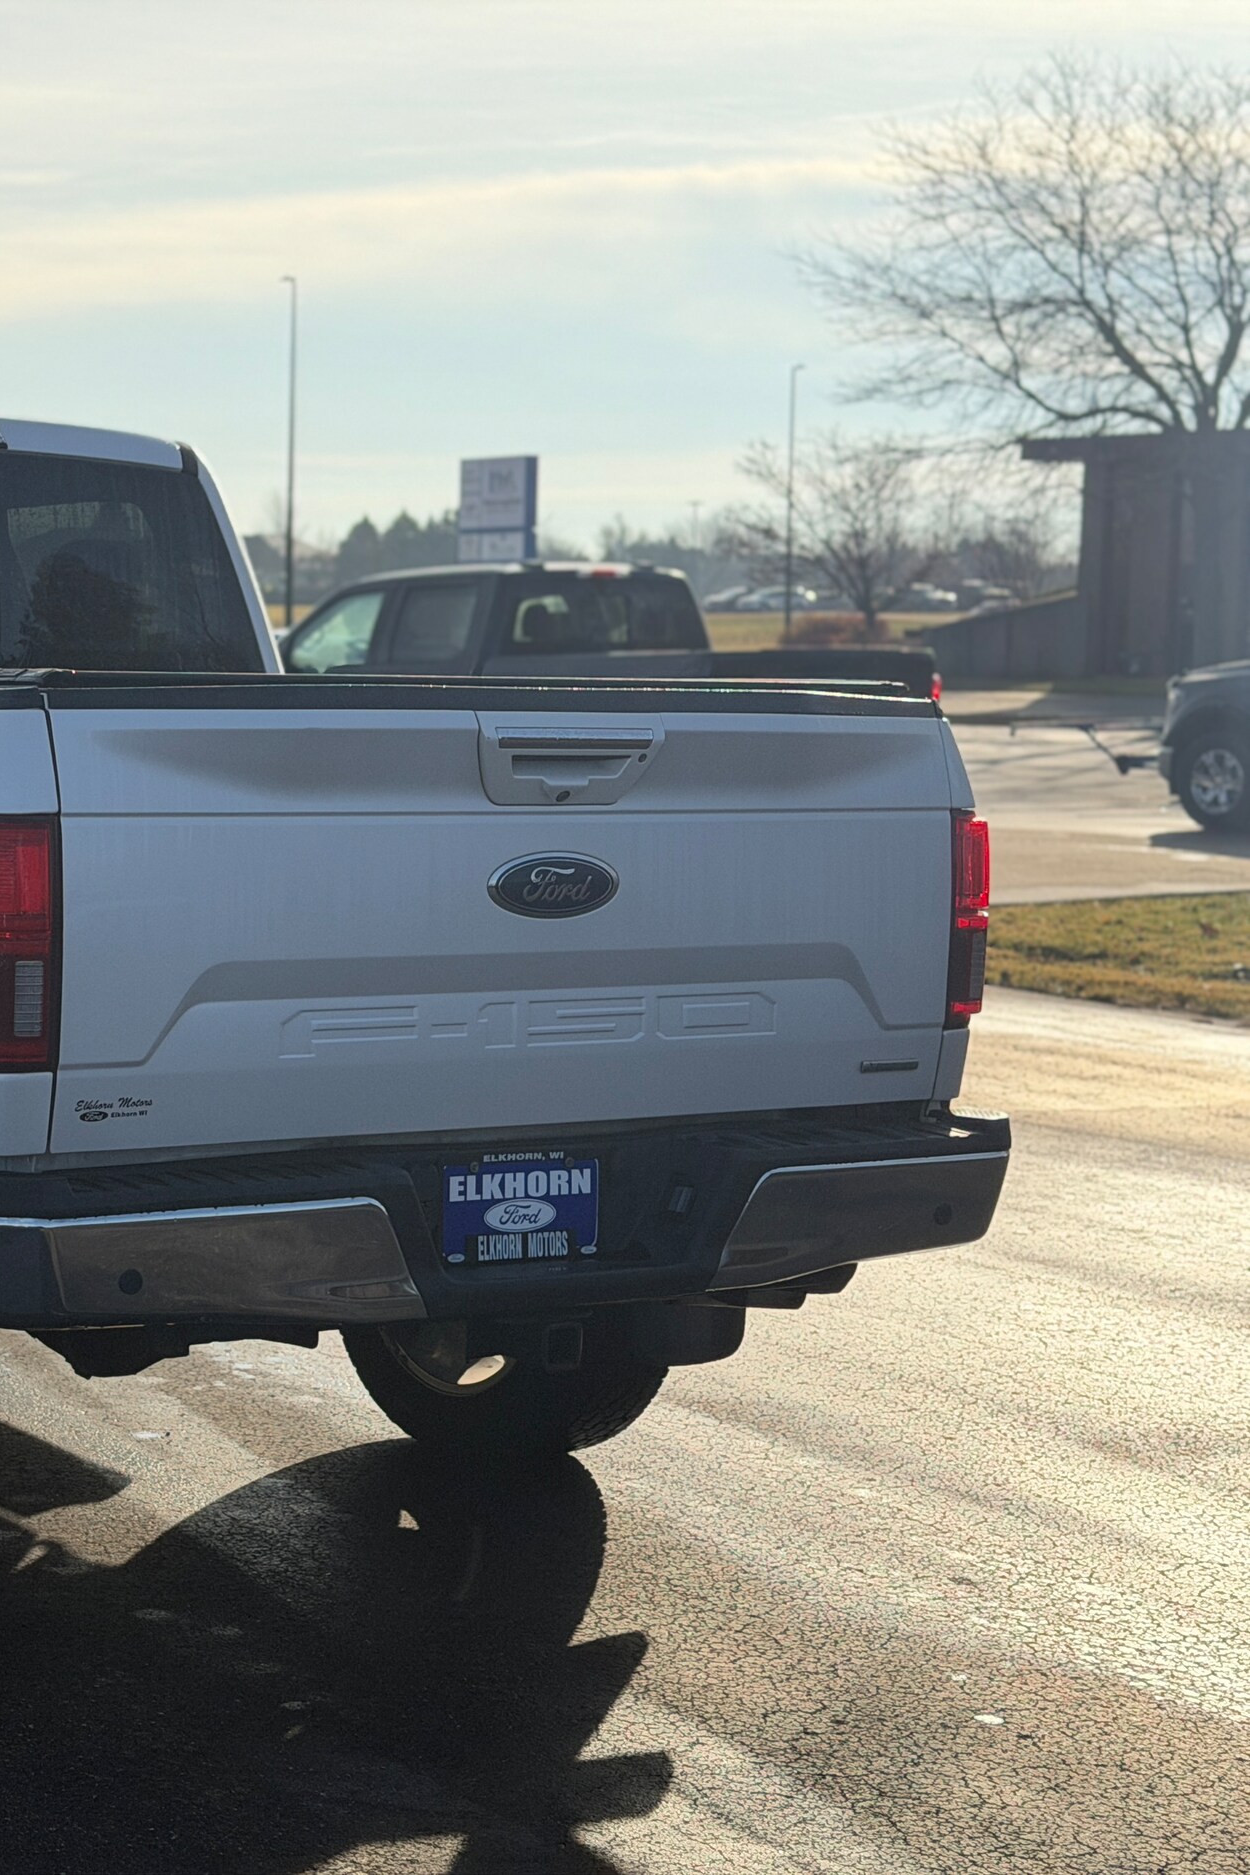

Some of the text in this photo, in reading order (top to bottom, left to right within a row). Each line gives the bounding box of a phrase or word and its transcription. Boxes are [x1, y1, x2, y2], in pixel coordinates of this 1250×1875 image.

[523, 866, 593, 901] Ford
[74, 1097, 153, 1112] Elkhorn Motors
[483, 1151, 564, 1163] ELKHORN, WI
[449, 1168, 592, 1203] ELKHORN
[499, 1204, 543, 1226] Ford
[477, 1231, 569, 1262] ELKHORN MOTORS
